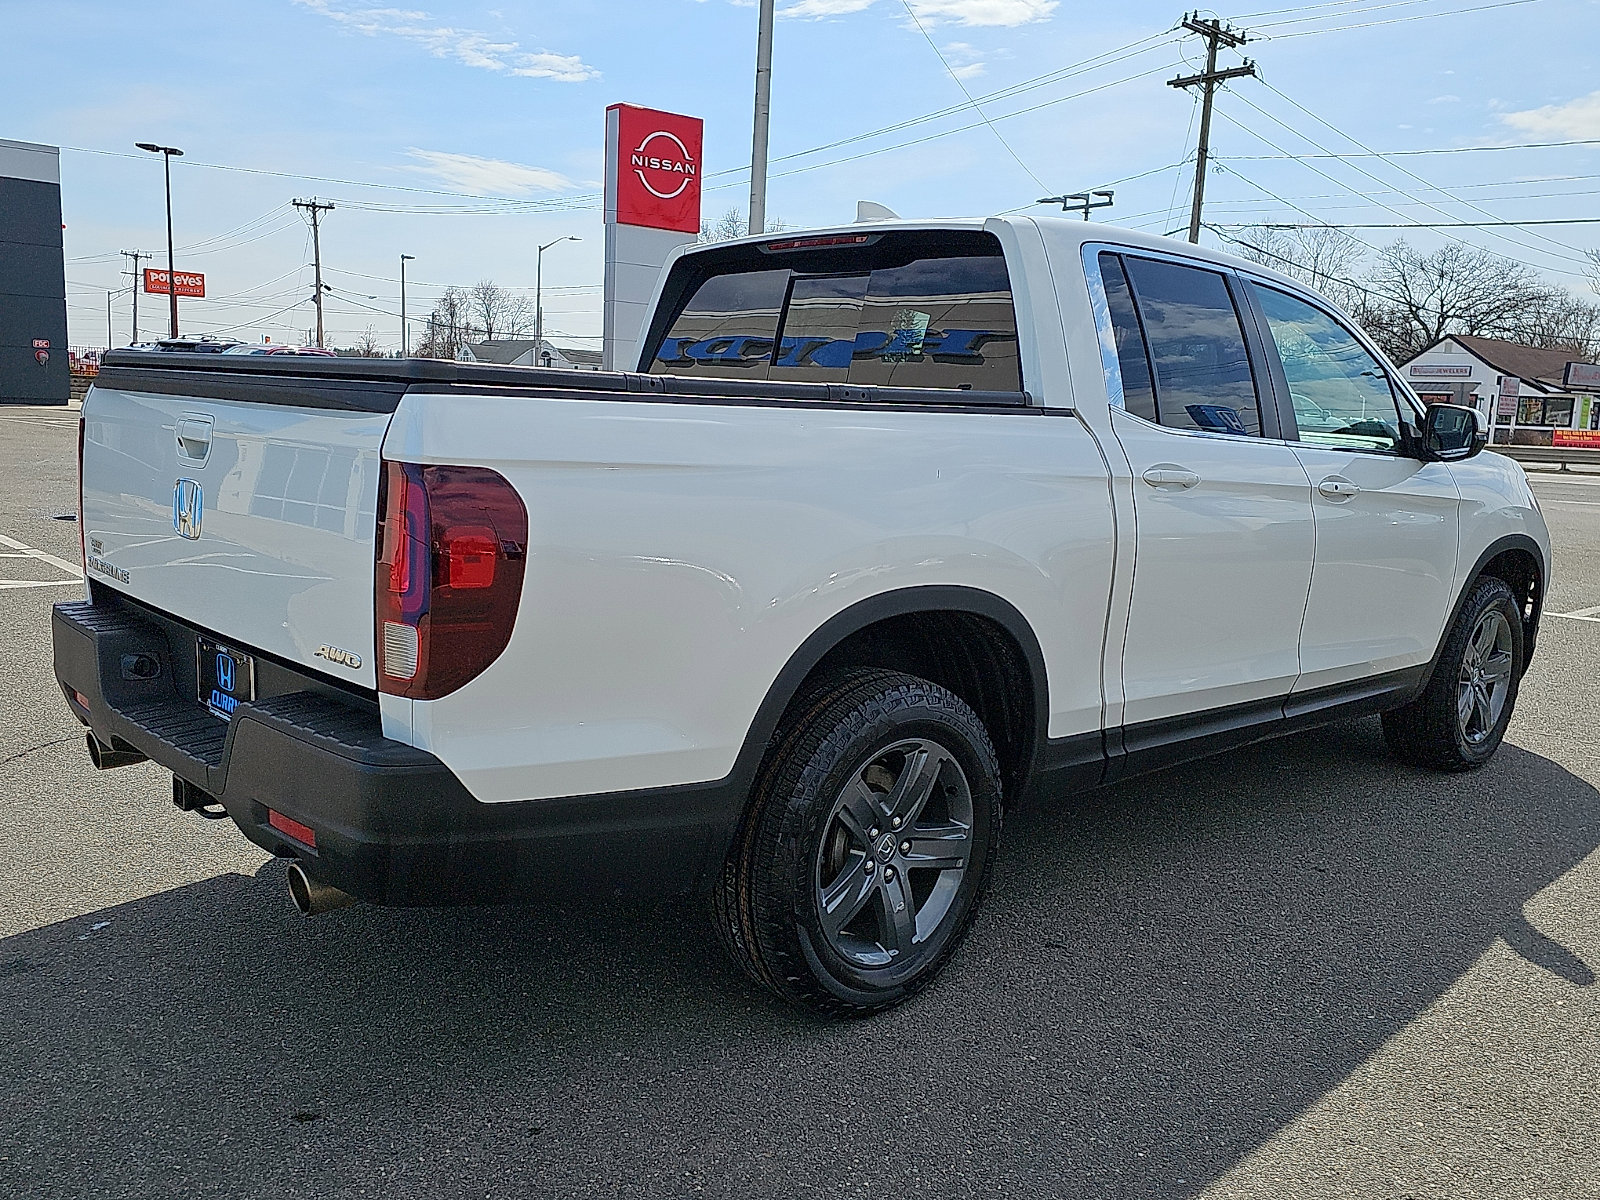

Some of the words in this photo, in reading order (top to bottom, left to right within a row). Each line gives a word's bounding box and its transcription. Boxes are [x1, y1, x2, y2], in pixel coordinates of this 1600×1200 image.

[631, 154, 695, 175] NISSAN
[313, 643, 363, 669] AWD
[211, 689, 241, 713] CURRY
